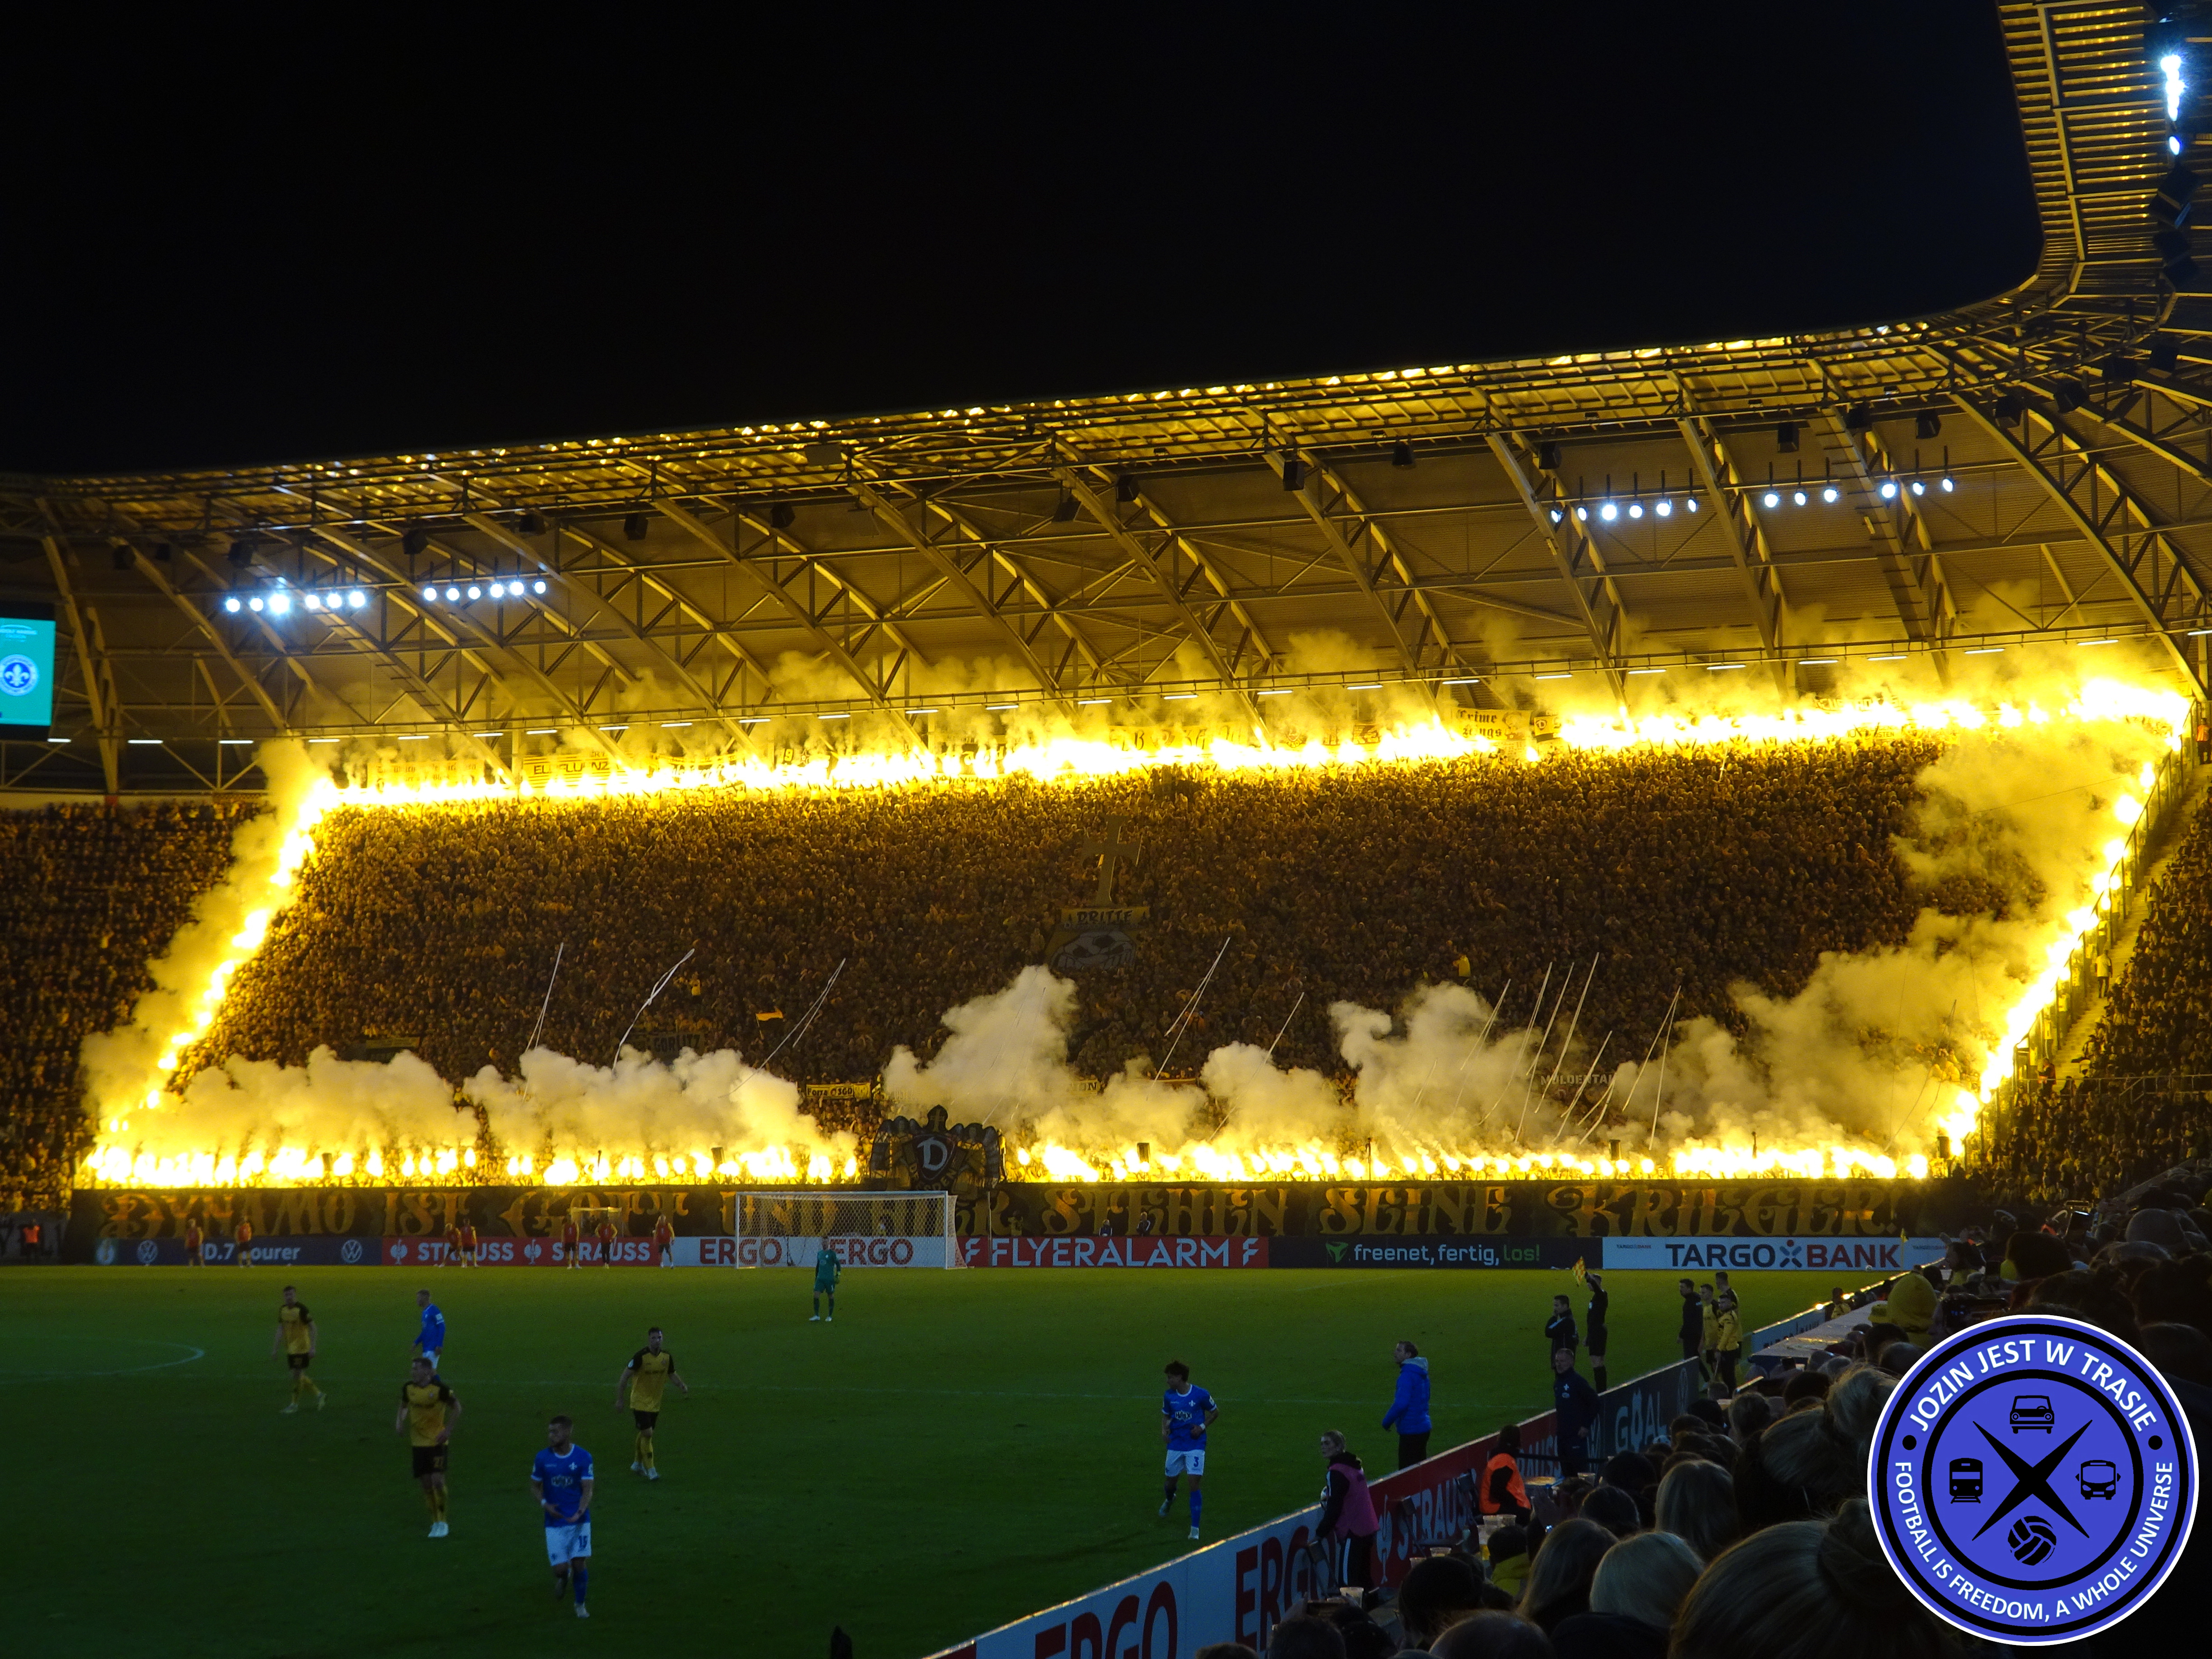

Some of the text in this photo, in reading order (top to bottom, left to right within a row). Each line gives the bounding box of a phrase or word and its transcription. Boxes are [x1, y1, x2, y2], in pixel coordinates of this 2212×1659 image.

[917, 1136, 948, 1171] D
[1040, 1187, 1288, 1237] STEHEN
[1318, 1185, 1512, 1236] SEINE
[699, 1238, 782, 1265] ERGO
[992, 1237, 1230, 1267] FLYERALARM
[1354, 1243, 1540, 1265] freenet, fertig, los!
[1193, 1456, 1199, 1467] 3
